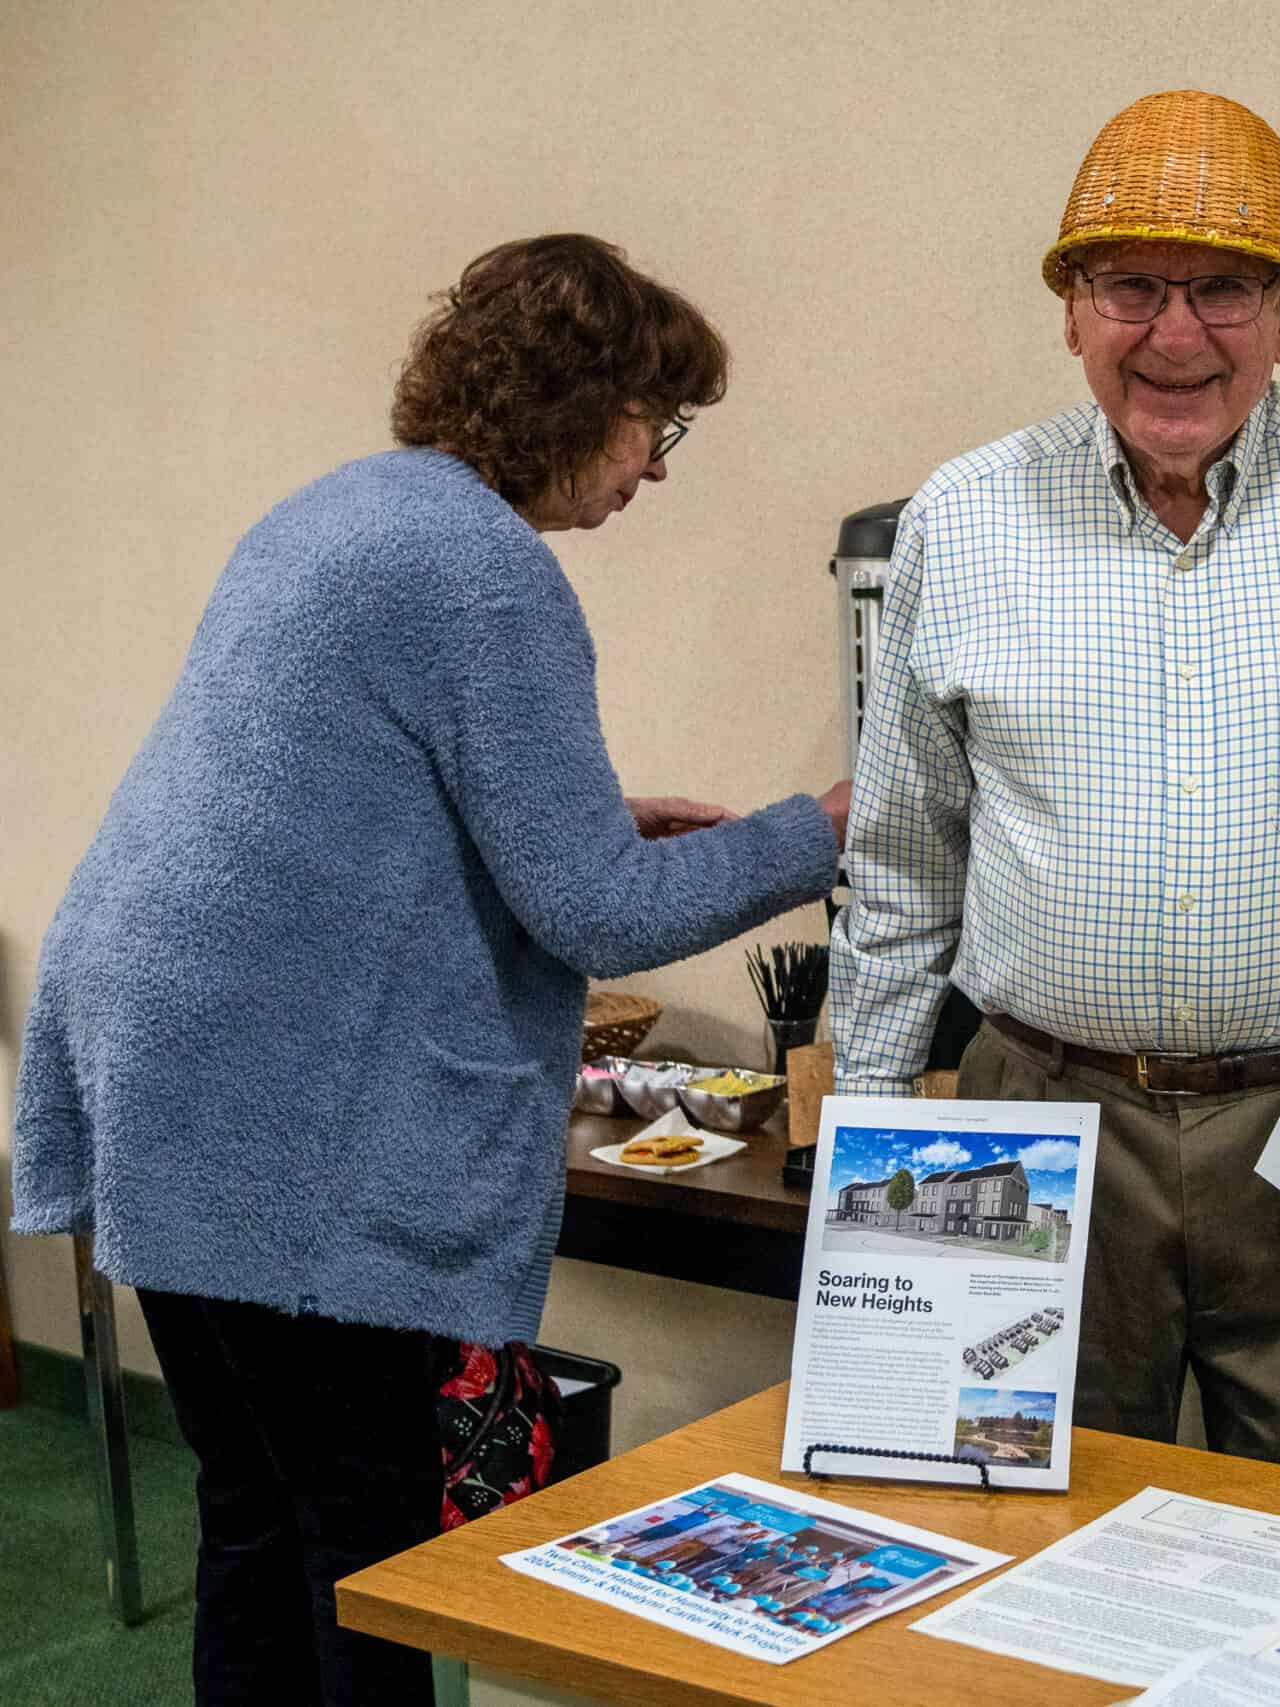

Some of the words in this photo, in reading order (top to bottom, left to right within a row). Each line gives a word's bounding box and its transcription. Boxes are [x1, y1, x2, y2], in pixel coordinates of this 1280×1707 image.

[818, 1270, 889, 1293] Soaring
[895, 1275, 913, 1291] to
[816, 1290, 856, 1308] New
[861, 1292, 933, 1314] Heights
